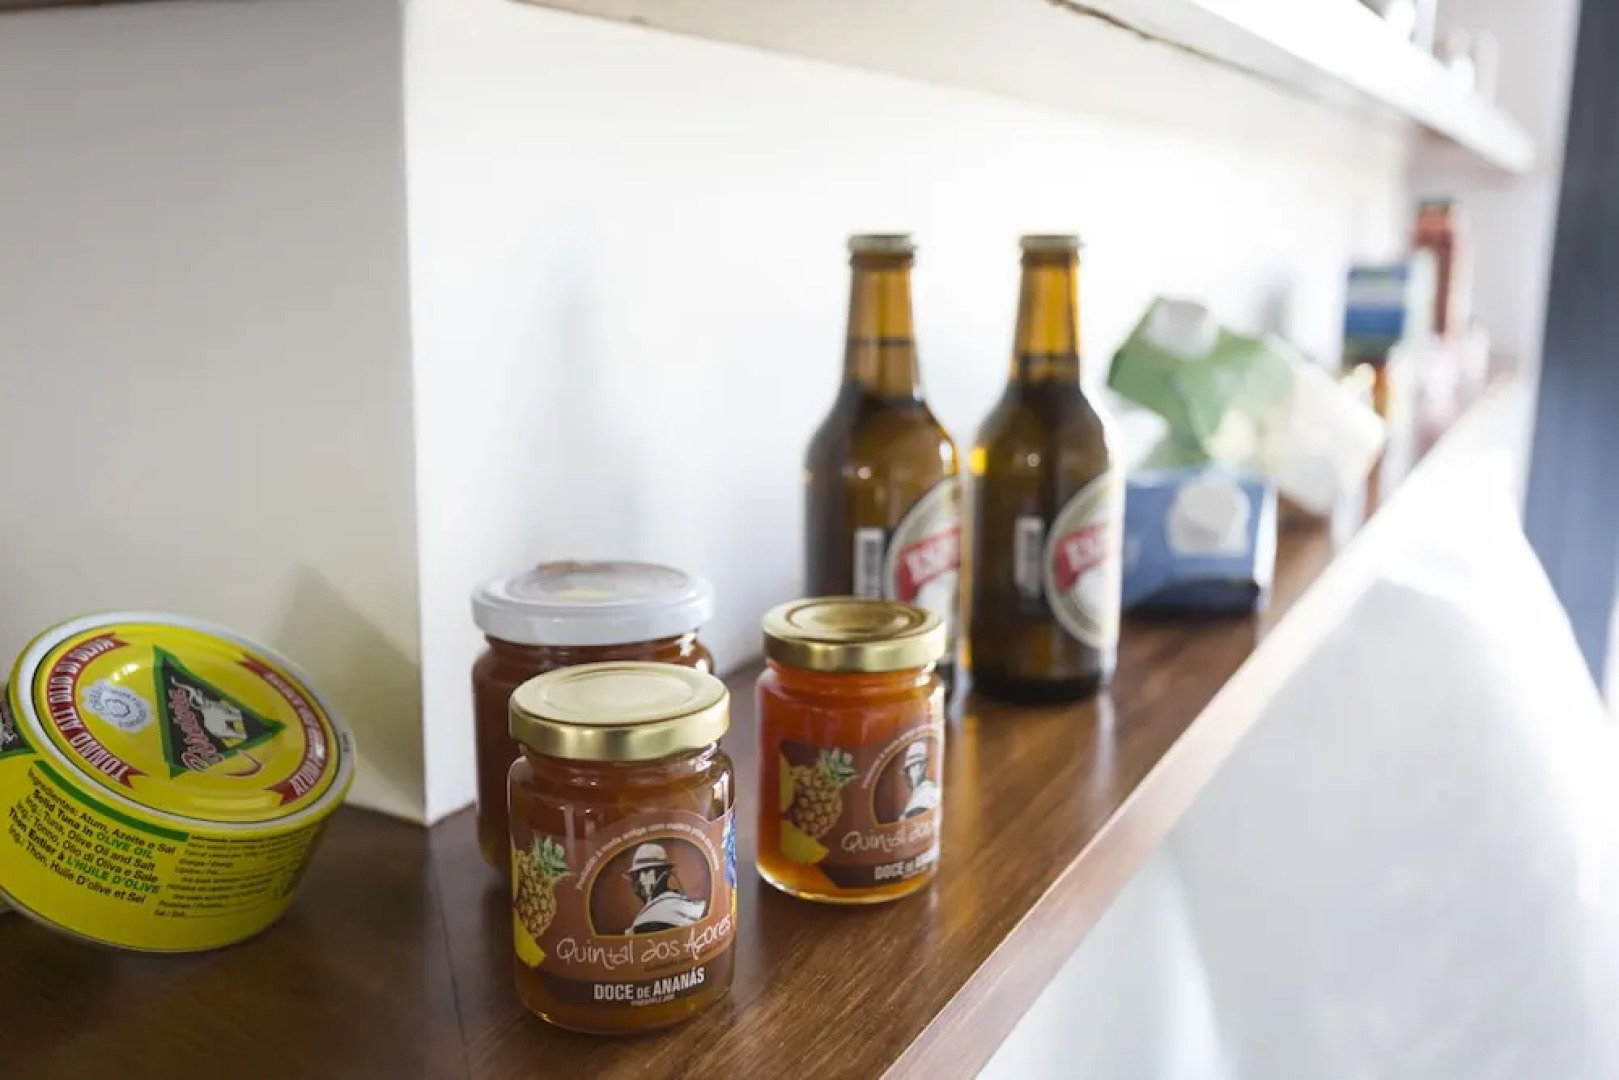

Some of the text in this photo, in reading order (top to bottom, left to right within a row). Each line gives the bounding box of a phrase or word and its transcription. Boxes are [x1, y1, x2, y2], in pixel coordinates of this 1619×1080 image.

[70, 732, 129, 781] TONNO
[57, 807, 80, 830] Tuna
[82, 824, 93, 838] in
[96, 831, 131, 853] OLIVE
[134, 846, 154, 859] OIL
[67, 829, 92, 849] Olive
[94, 844, 109, 856] Oil
[110, 851, 132, 865] and
[133, 857, 156, 872] Salt
[157, 842, 177, 855] Sal
[841, 825, 906, 853] Quintal
[66, 854, 108, 881] L'HUILE
[112, 875, 159, 895] D'OLIVE
[133, 870, 158, 883] Sale
[556, 914, 732, 970] Quintal dos Açores
[594, 984, 634, 1000] DOCE
[653, 967, 705, 996] ANANÁS
